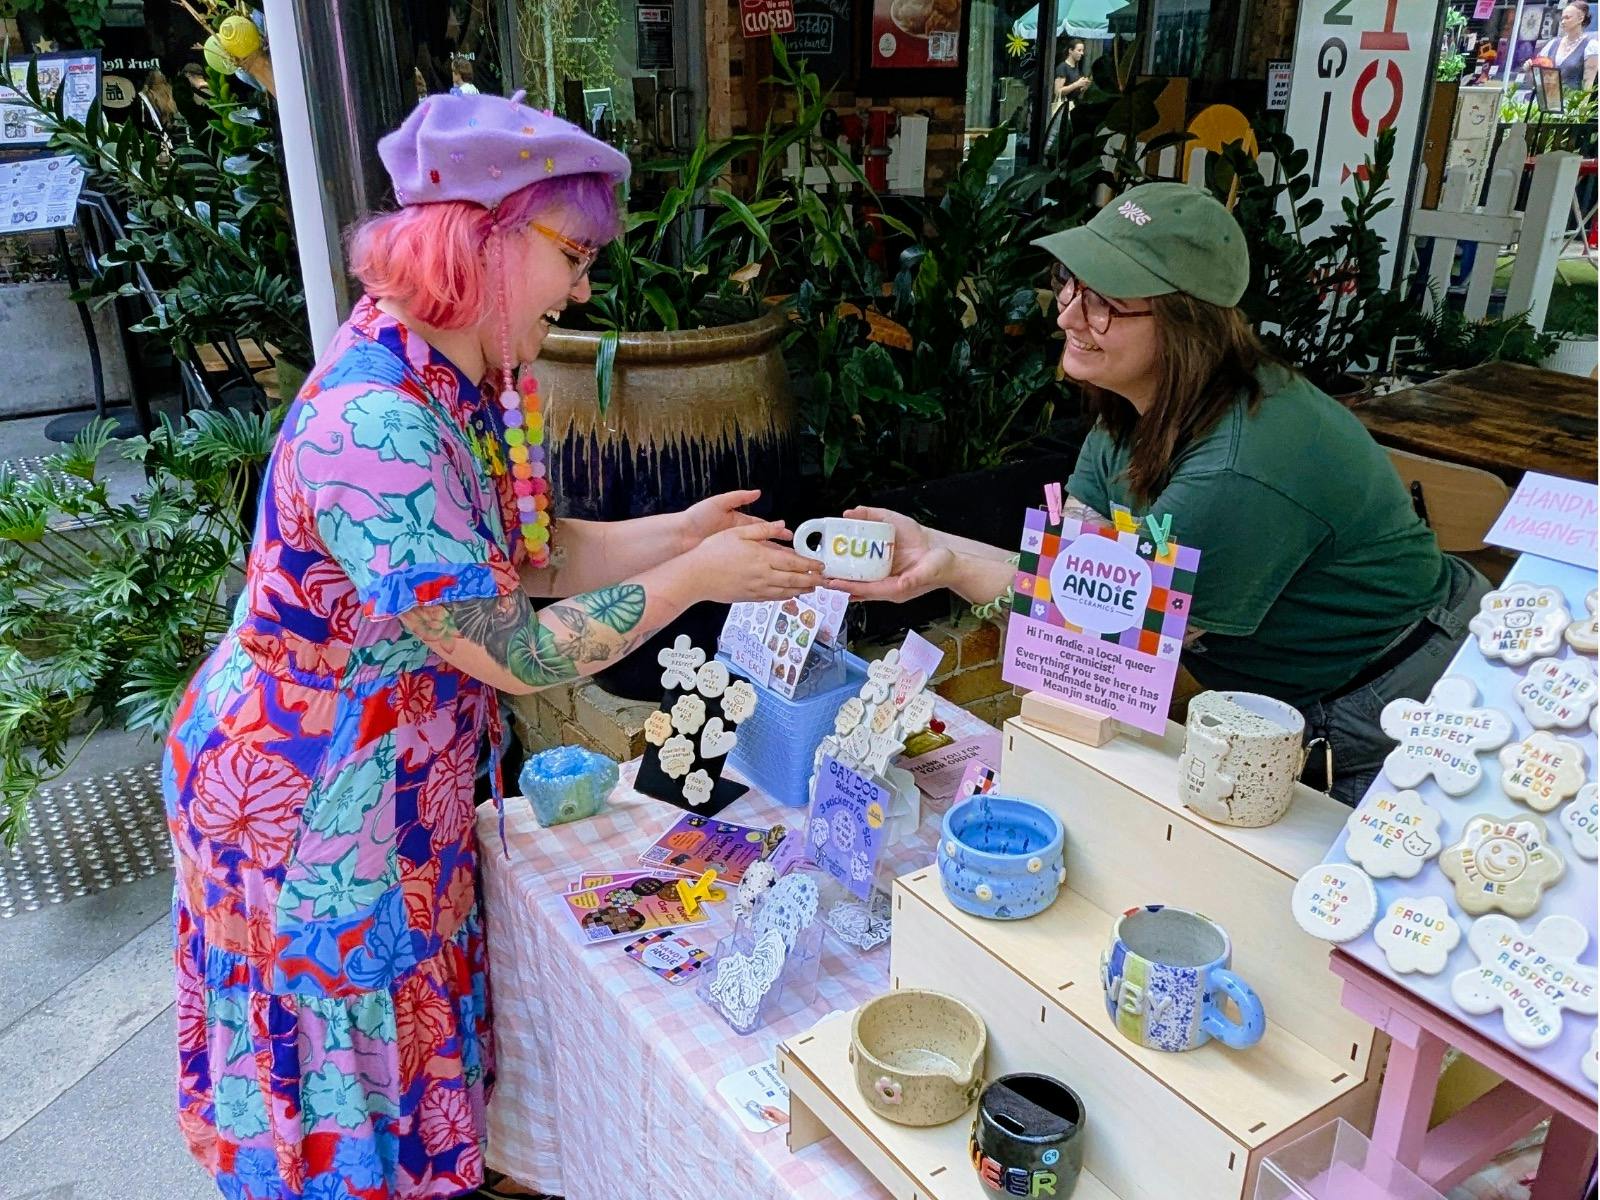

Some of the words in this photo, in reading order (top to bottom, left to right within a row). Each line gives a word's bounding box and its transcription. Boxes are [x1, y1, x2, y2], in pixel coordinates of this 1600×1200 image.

[744, 9, 793, 32] CLOSED
[832, 534, 895, 560] CUNT
[1066, 555, 1142, 587] HANDY
[1078, 598, 1115, 614] CERAMICS
[1492, 598, 1511, 609] MY
[1516, 596, 1549, 608] DOG
[1493, 628, 1544, 640] HATES
[1499, 639, 1530, 650] MEN
[1026, 625, 1036, 636] Hi
[1087, 647, 1095, 656] a
[1096, 646, 1123, 666] local
[1124, 658, 1157, 674] queer
[1016, 646, 1071, 674] Everything
[1072, 666, 1092, 680] you
[1093, 673, 1112, 686] see
[1113, 678, 1138, 695] here
[1140, 686, 1159, 700] has
[1059, 650, 1116, 675] ceramicist!
[1014, 658, 1039, 675] been
[1040, 666, 1092, 691] handmade
[1094, 682, 1107, 698] by
[1109, 689, 1126, 701] me
[1127, 693, 1138, 706] in
[1139, 699, 1157, 714] my
[1543, 680, 1572, 699] GAY
[1562, 673, 1590, 693] THE
[1084, 693, 1119, 712] studio.
[1521, 683, 1570, 720] COUSIN
[1402, 711, 1431, 723] HOT
[1435, 713, 1493, 730] PEOPLE
[1410, 727, 1475, 745] RESPECT
[910, 759, 942, 773] THANK
[942, 751, 960, 765] YOU
[962, 745, 981, 756] FOR
[920, 762, 946, 775] YOUR
[947, 752, 979, 767] ORDER
[1406, 745, 1478, 776] PRONOUNS
[1522, 743, 1562, 768] TAKE
[829, 760, 853, 784] GAY
[854, 777, 879, 801] DOG
[1516, 758, 1556, 784] YOUR
[835, 780, 856, 801] Sticker
[857, 794, 868, 807] Set
[1510, 773, 1552, 798] MEDS
[819, 803, 827, 814] 3
[826, 794, 854, 811] stickers
[853, 807, 866, 824] for
[1377, 799, 1395, 812] MY
[1395, 813, 1422, 827] CAT
[1360, 814, 1404, 839] HATES
[1373, 834, 1392, 848] ME
[1481, 823, 1544, 862] PLEASE
[1323, 874, 1346, 889] gay
[1483, 882, 1506, 895] ME
[1311, 893, 1340, 913] pray
[1328, 889, 1348, 903] the
[1309, 905, 1342, 925] away
[1393, 905, 1446, 932] PROUD
[1392, 924, 1433, 945] DYKE
[657, 944, 685, 961] HANDY
[1500, 934, 1535, 957] HOT
[1533, 955, 1593, 996] PEOPLE
[1497, 952, 1565, 1001] RESPECT
[1482, 969, 1551, 1036] PRONOUNS
[1043, 1151, 1057, 1162] 69
